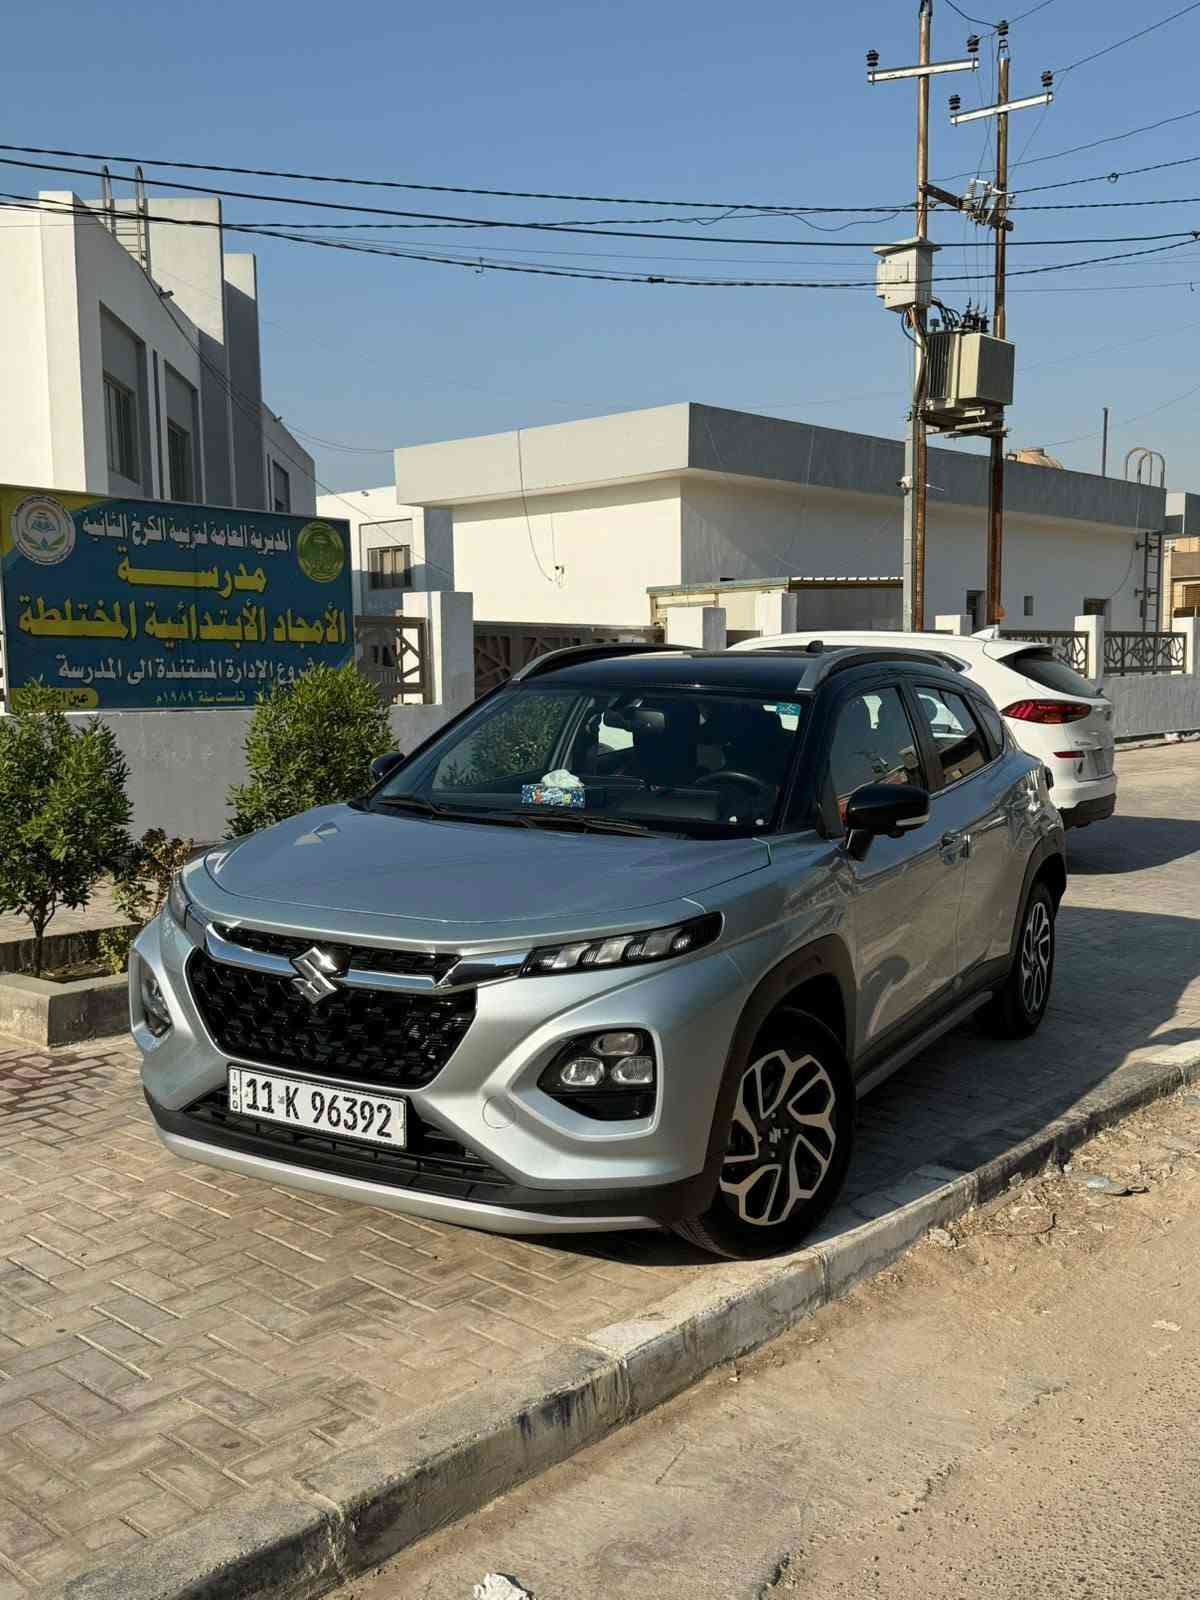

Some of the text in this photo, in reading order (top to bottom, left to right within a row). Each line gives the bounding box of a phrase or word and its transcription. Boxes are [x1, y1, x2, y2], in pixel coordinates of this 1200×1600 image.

[82, 508, 127, 541] الثانية
[131, 513, 166, 546] الكرخ
[169, 517, 208, 550] لتربية
[210, 520, 247, 547] العامة
[249, 525, 291, 555] المديرية
[18, 593, 136, 639] المختلطة
[273, 601, 346, 648] الأمجاد
[56, 654, 121, 684] المدرسة
[156, 658, 223, 679] المستندة
[246, 1078, 393, 1138] 11 K 96392
